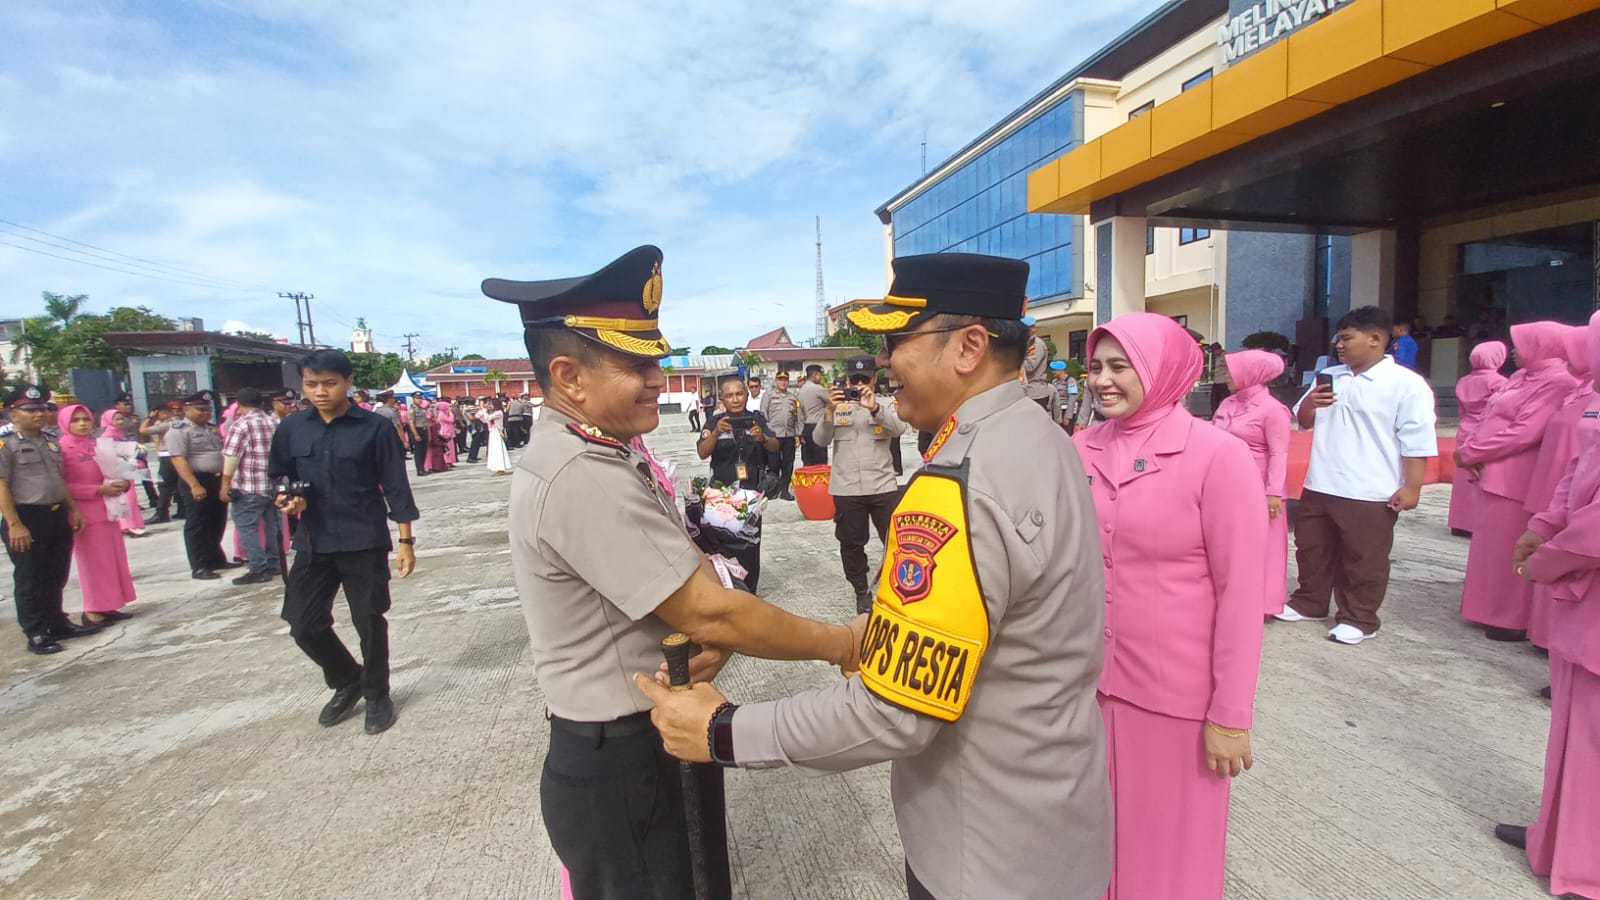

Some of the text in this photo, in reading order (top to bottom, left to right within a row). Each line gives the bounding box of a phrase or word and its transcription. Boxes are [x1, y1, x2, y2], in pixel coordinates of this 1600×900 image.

[897, 515, 949, 535] POLRESTA
[861, 614, 968, 704] OPS RESTA
